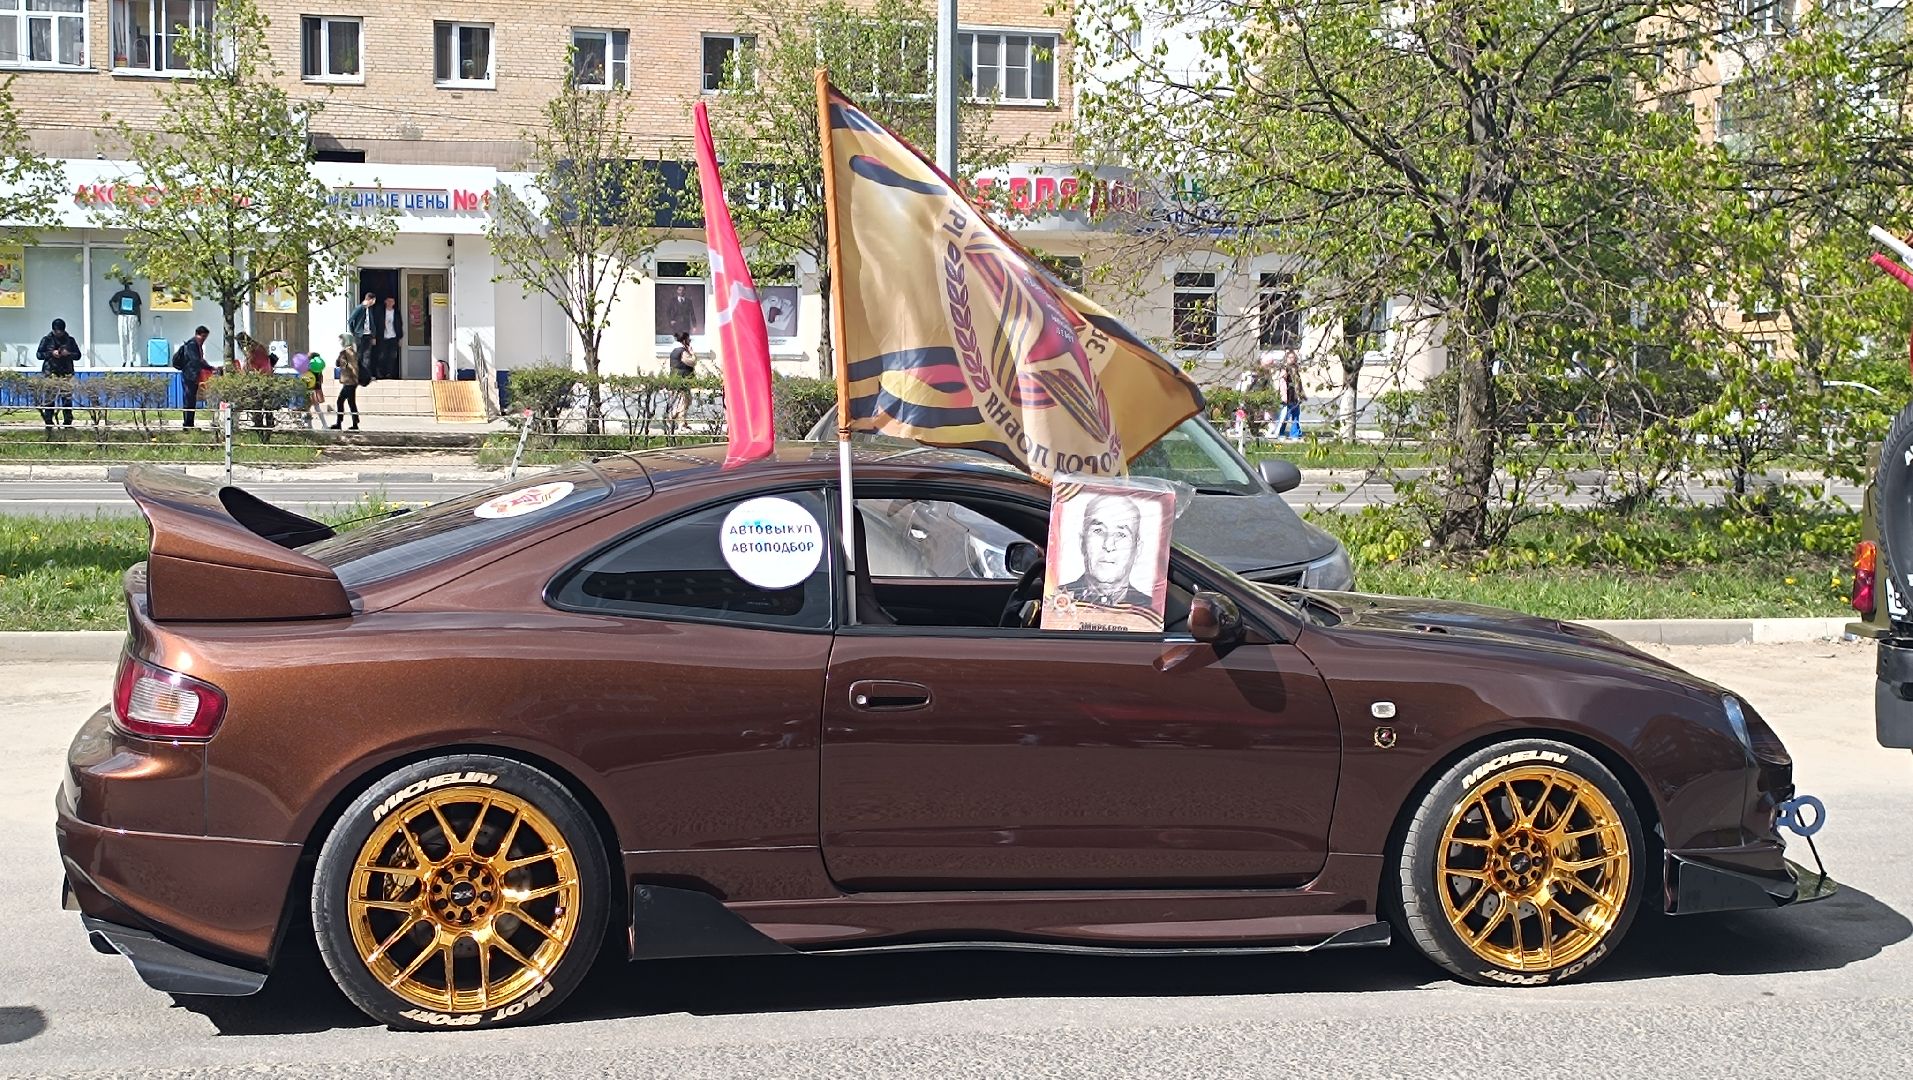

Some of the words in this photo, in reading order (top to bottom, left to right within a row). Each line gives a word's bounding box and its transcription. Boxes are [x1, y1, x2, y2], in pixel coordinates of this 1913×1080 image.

[405, 193, 449, 211] ЦЕНЫ
[729, 524, 813, 535] АВТОВЫКУП
[731, 541, 815, 554] АВТОПОДБОР
[1461, 749, 1569, 790] MICHELIN
[372, 771, 498, 822] MICHELIN
[1556, 942, 1608, 981] PILOT
[1478, 969, 1552, 985] SPORT
[491, 981, 555, 1021] PILOT
[399, 1008, 483, 1027] SPORT
